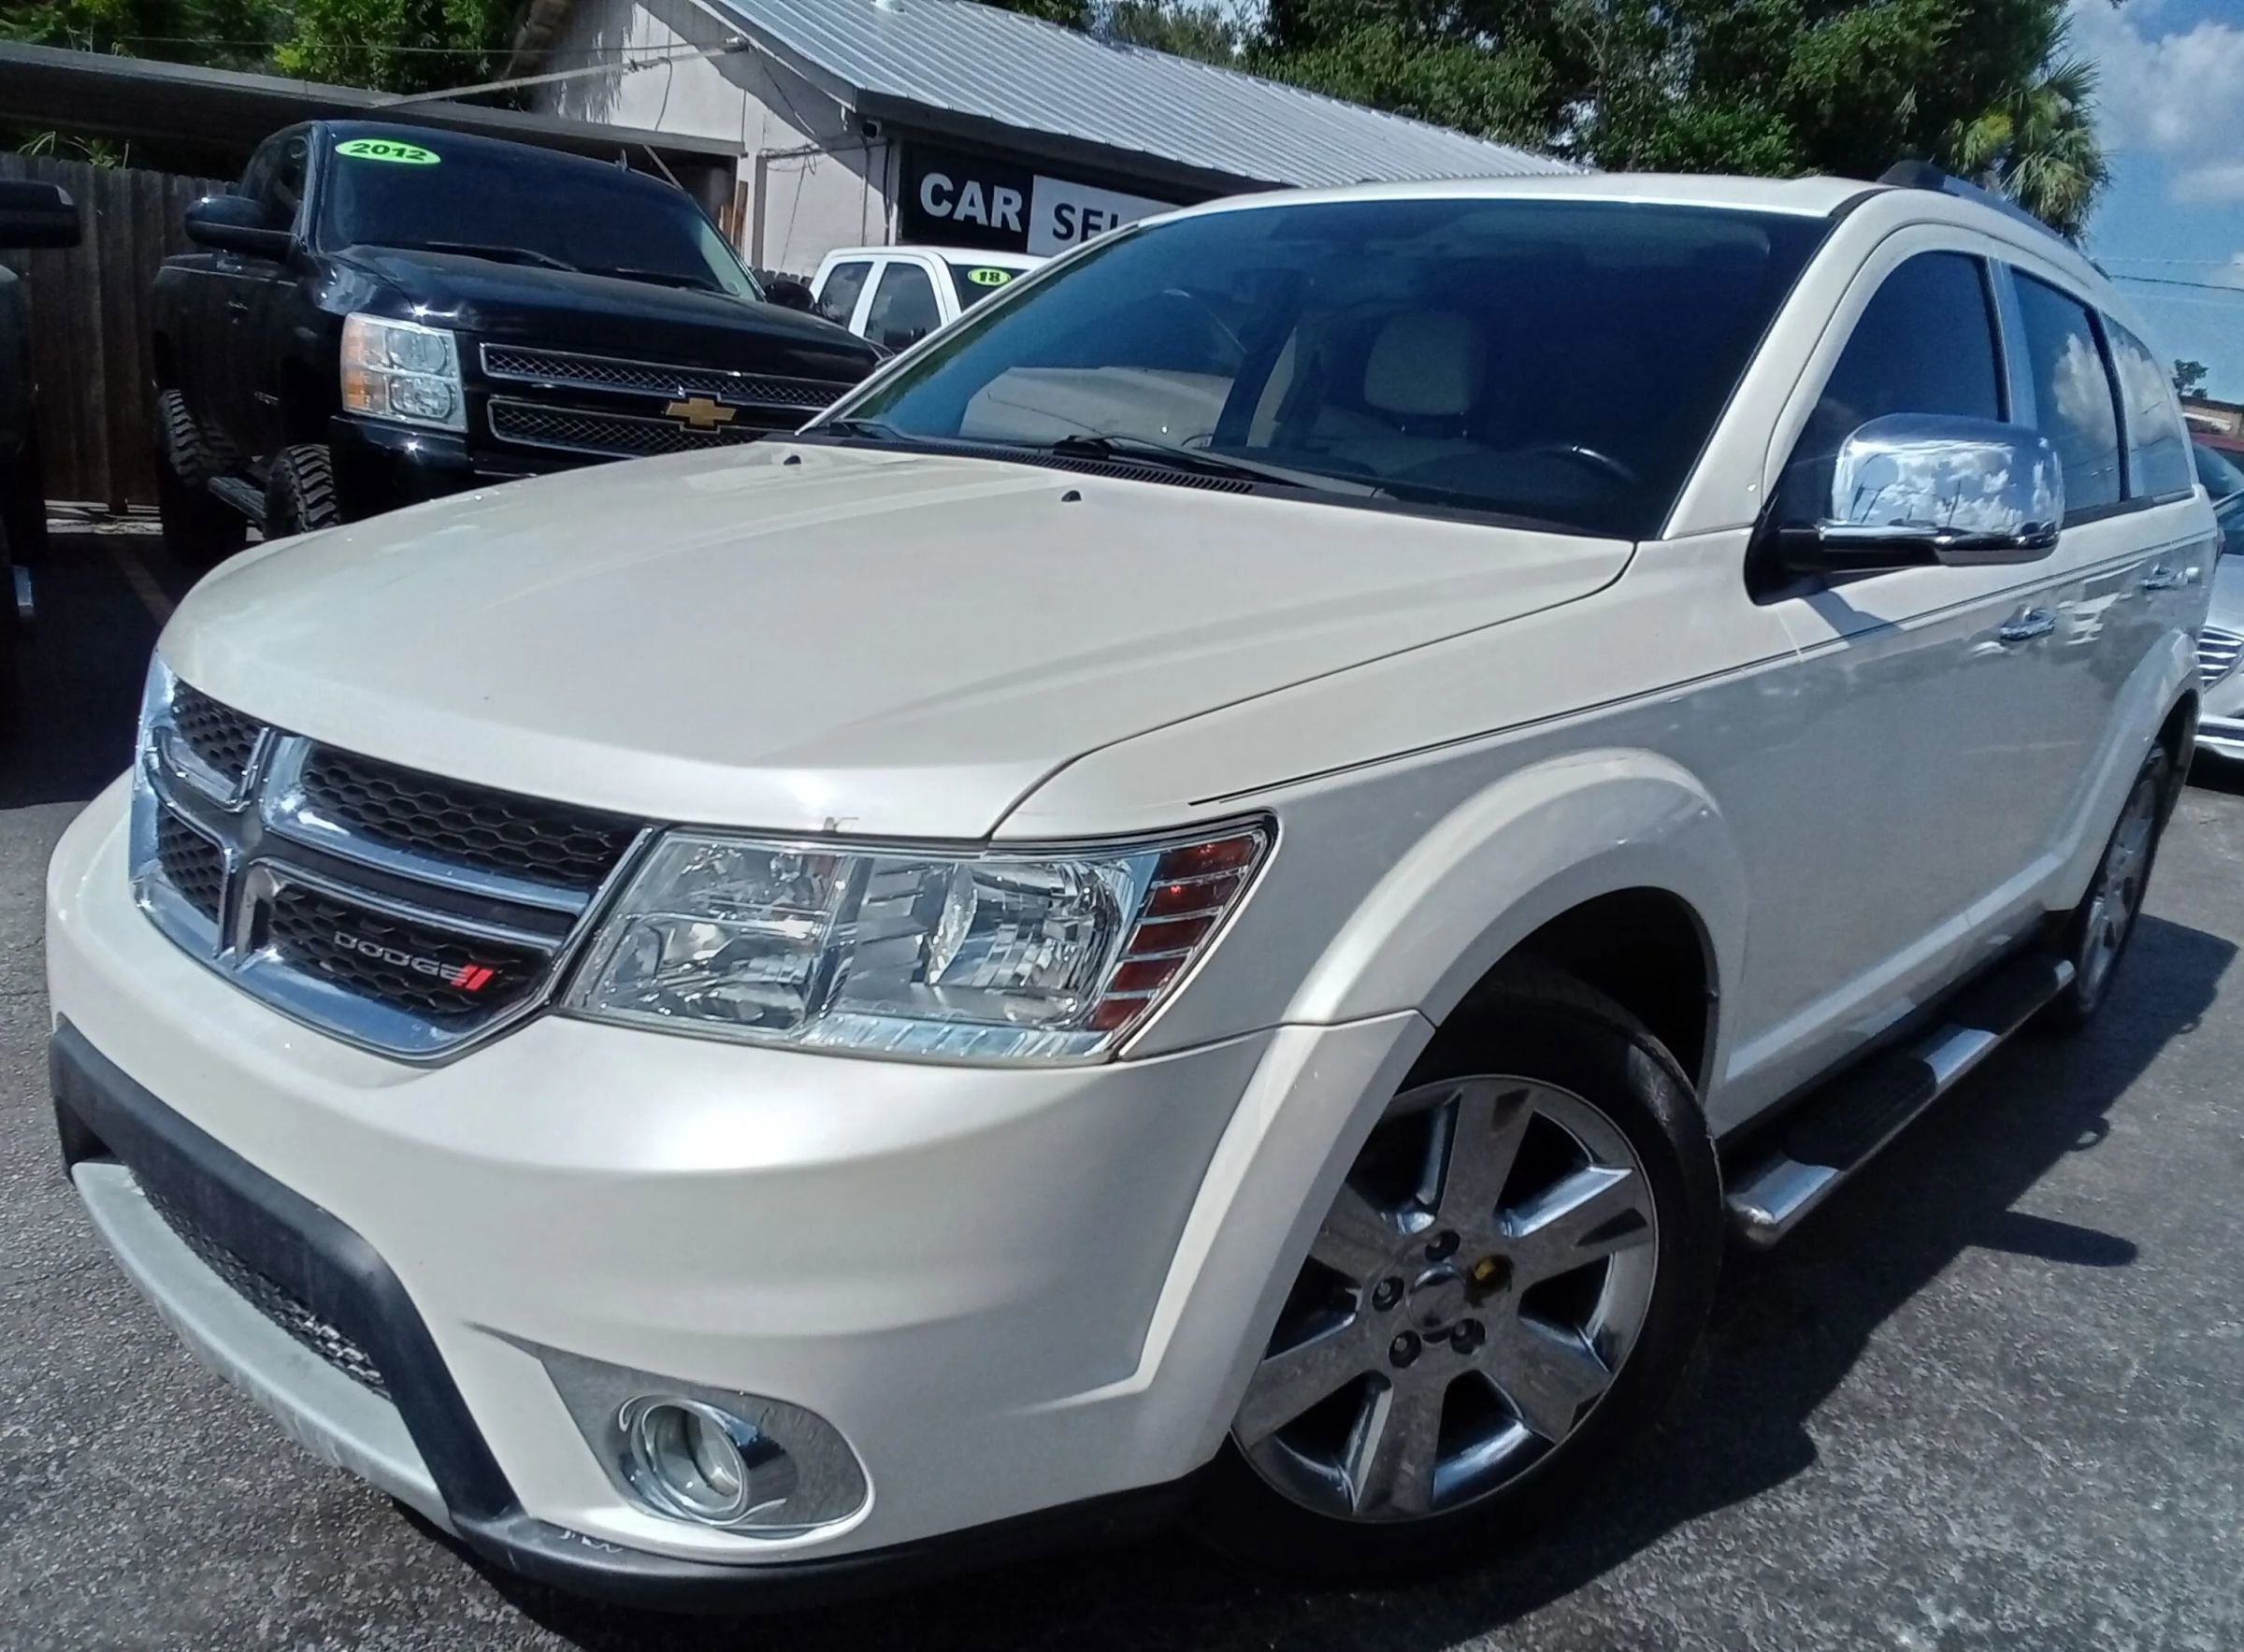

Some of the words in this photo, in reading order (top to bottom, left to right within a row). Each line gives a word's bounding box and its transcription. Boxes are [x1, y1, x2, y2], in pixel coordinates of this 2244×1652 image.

[349, 142, 427, 162] 2012
[920, 172, 1023, 233] CAR
[979, 271, 1000, 283] 18
[334, 930, 468, 983] DODGE
